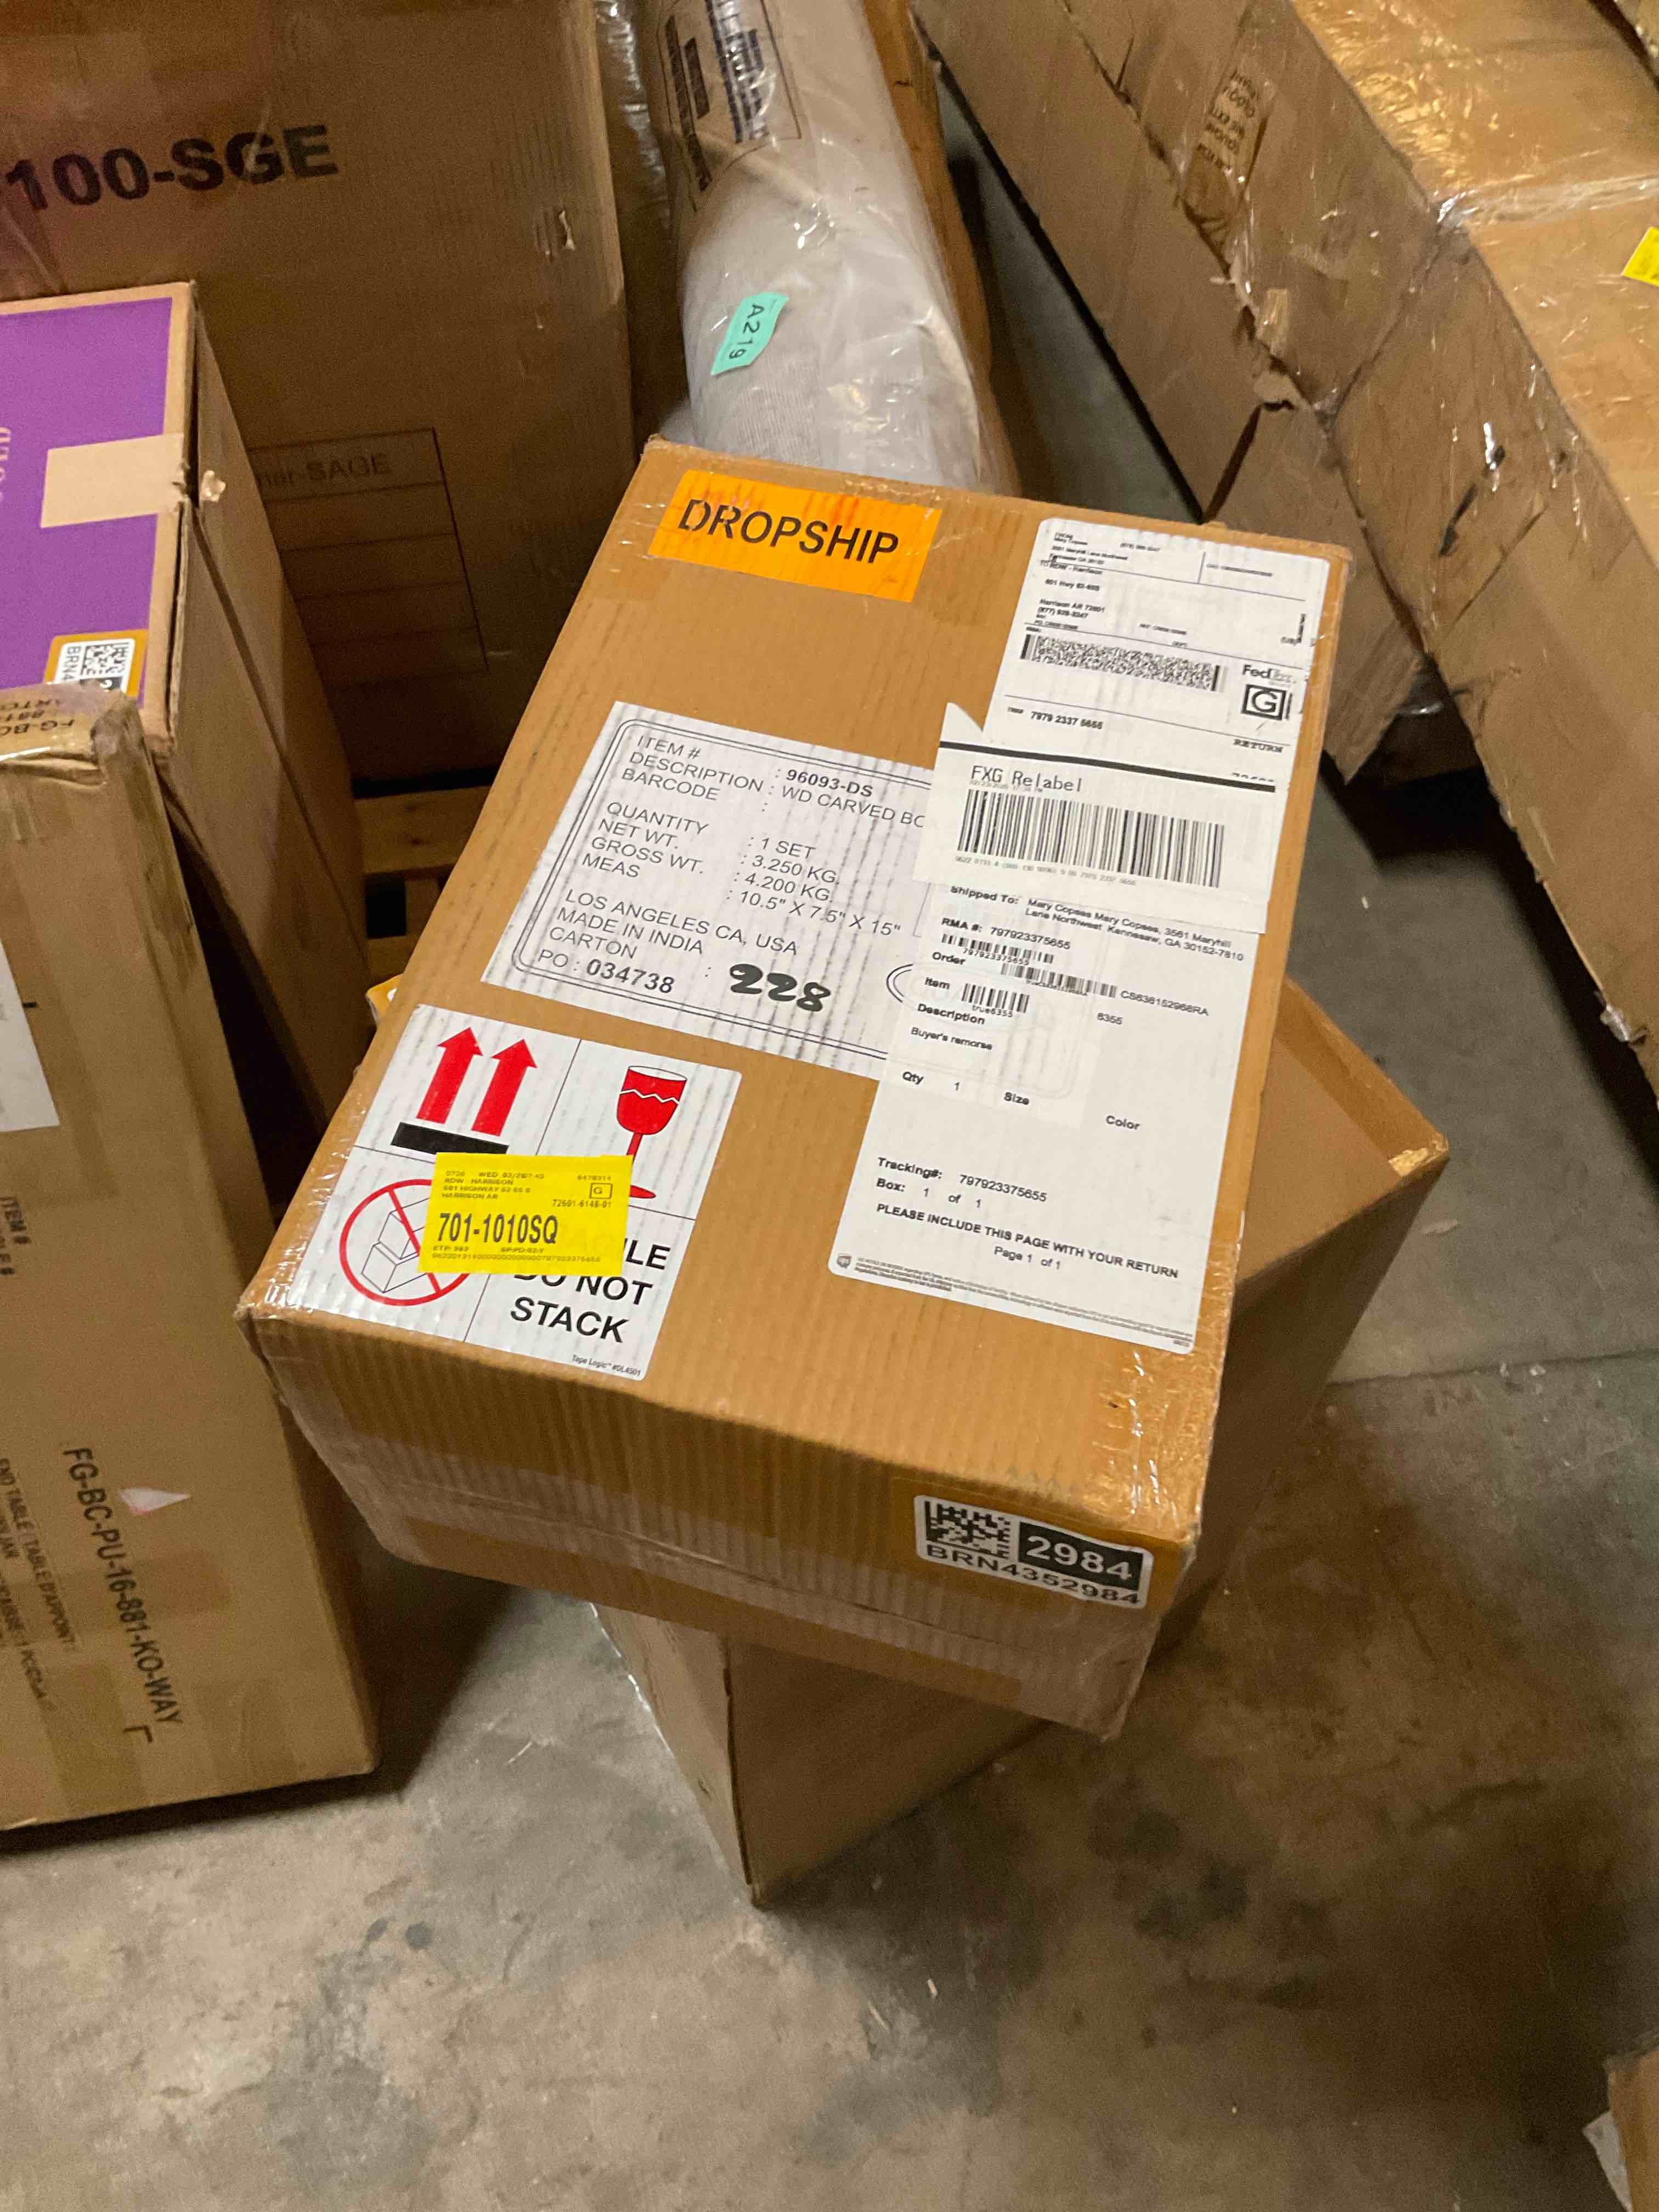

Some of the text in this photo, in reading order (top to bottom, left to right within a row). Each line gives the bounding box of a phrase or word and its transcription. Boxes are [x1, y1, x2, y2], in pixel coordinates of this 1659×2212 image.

[5, 124, 339, 210] 100-SGE
[678, 498, 900, 564] DROPSHIP
[1039, 598, 1070, 608] Harrison
[1071, 602, 1083, 611] AR
[1059, 580, 1075, 589] Hwy
[1030, 710, 1053, 723] 7979
[1054, 715, 1079, 726] 2337
[1251, 689, 1278, 713] G
[1233, 738, 1284, 753] RETURN
[621, 768, 720, 801] BARCODE
[636, 735, 874, 798] ITEM # 96093-DS
[970, 765, 1003, 783] FXG
[1012, 770, 1083, 792] Relabel
[629, 752, 765, 793] DESCRIPTION
[780, 785, 813, 803] WD
[816, 794, 897, 822] CARVED
[597, 818, 840, 884] NET WT. 3.250 KG.
[606, 802, 816, 860] QUANTITY 1 SET
[591, 837, 833, 904] GROSS WT. 4.200 KG.
[581, 853, 902, 938] MEAS 10.5" X 7.5" X 15"
[950, 885, 997, 903] Shipped
[1000, 893, 1019, 906] To:
[1028, 898, 1053, 912] Mary
[1094, 911, 1122, 927] Mary
[556, 906, 704, 955] MADE IN INDIA
[565, 889, 798, 956] LOS ANGELES CA, USA
[941, 917, 969, 931] RMA
[1024, 909, 1051, 922] Lane
[1052, 914, 1103, 932] Northwest
[1164, 936, 1182, 949] GA
[549, 926, 638, 960] CARTON
[932, 951, 967, 967] Order
[537, 949, 675, 994] PO 034738
[727, 962, 832, 1013] 228
[924, 976, 951, 991] Item
[917, 1002, 986, 1026] Description
[910, 1026, 994, 1051] Buyer's remorse
[901, 1070, 1141, 1132] Qty 1 Size Color
[459, 1184, 499, 1193] HIGHWAY
[471, 1178, 514, 1186] HARRISON
[593, 1186, 603, 1195] G
[876, 1177, 982, 1209] Box: 1 of 1
[877, 1156, 1048, 1203] Tracking#: 797923375655
[437, 1211, 558, 1245] 701-1010SQ
[876, 1203, 1180, 1280] PLEASE INCLUDE THIS PAGE WITH YOUR RETURN
[994, 1245, 1062, 1271] Page 1 of 1
[575, 1275, 654, 1306] NOT
[510, 1296, 630, 1344] STACK
[926, 1543, 1141, 1605] BRN4352984
[1025, 1535, 1133, 1581] 2984
[63, 1447, 183, 1725] FG-BC-PU-16-881-KO-WAY
